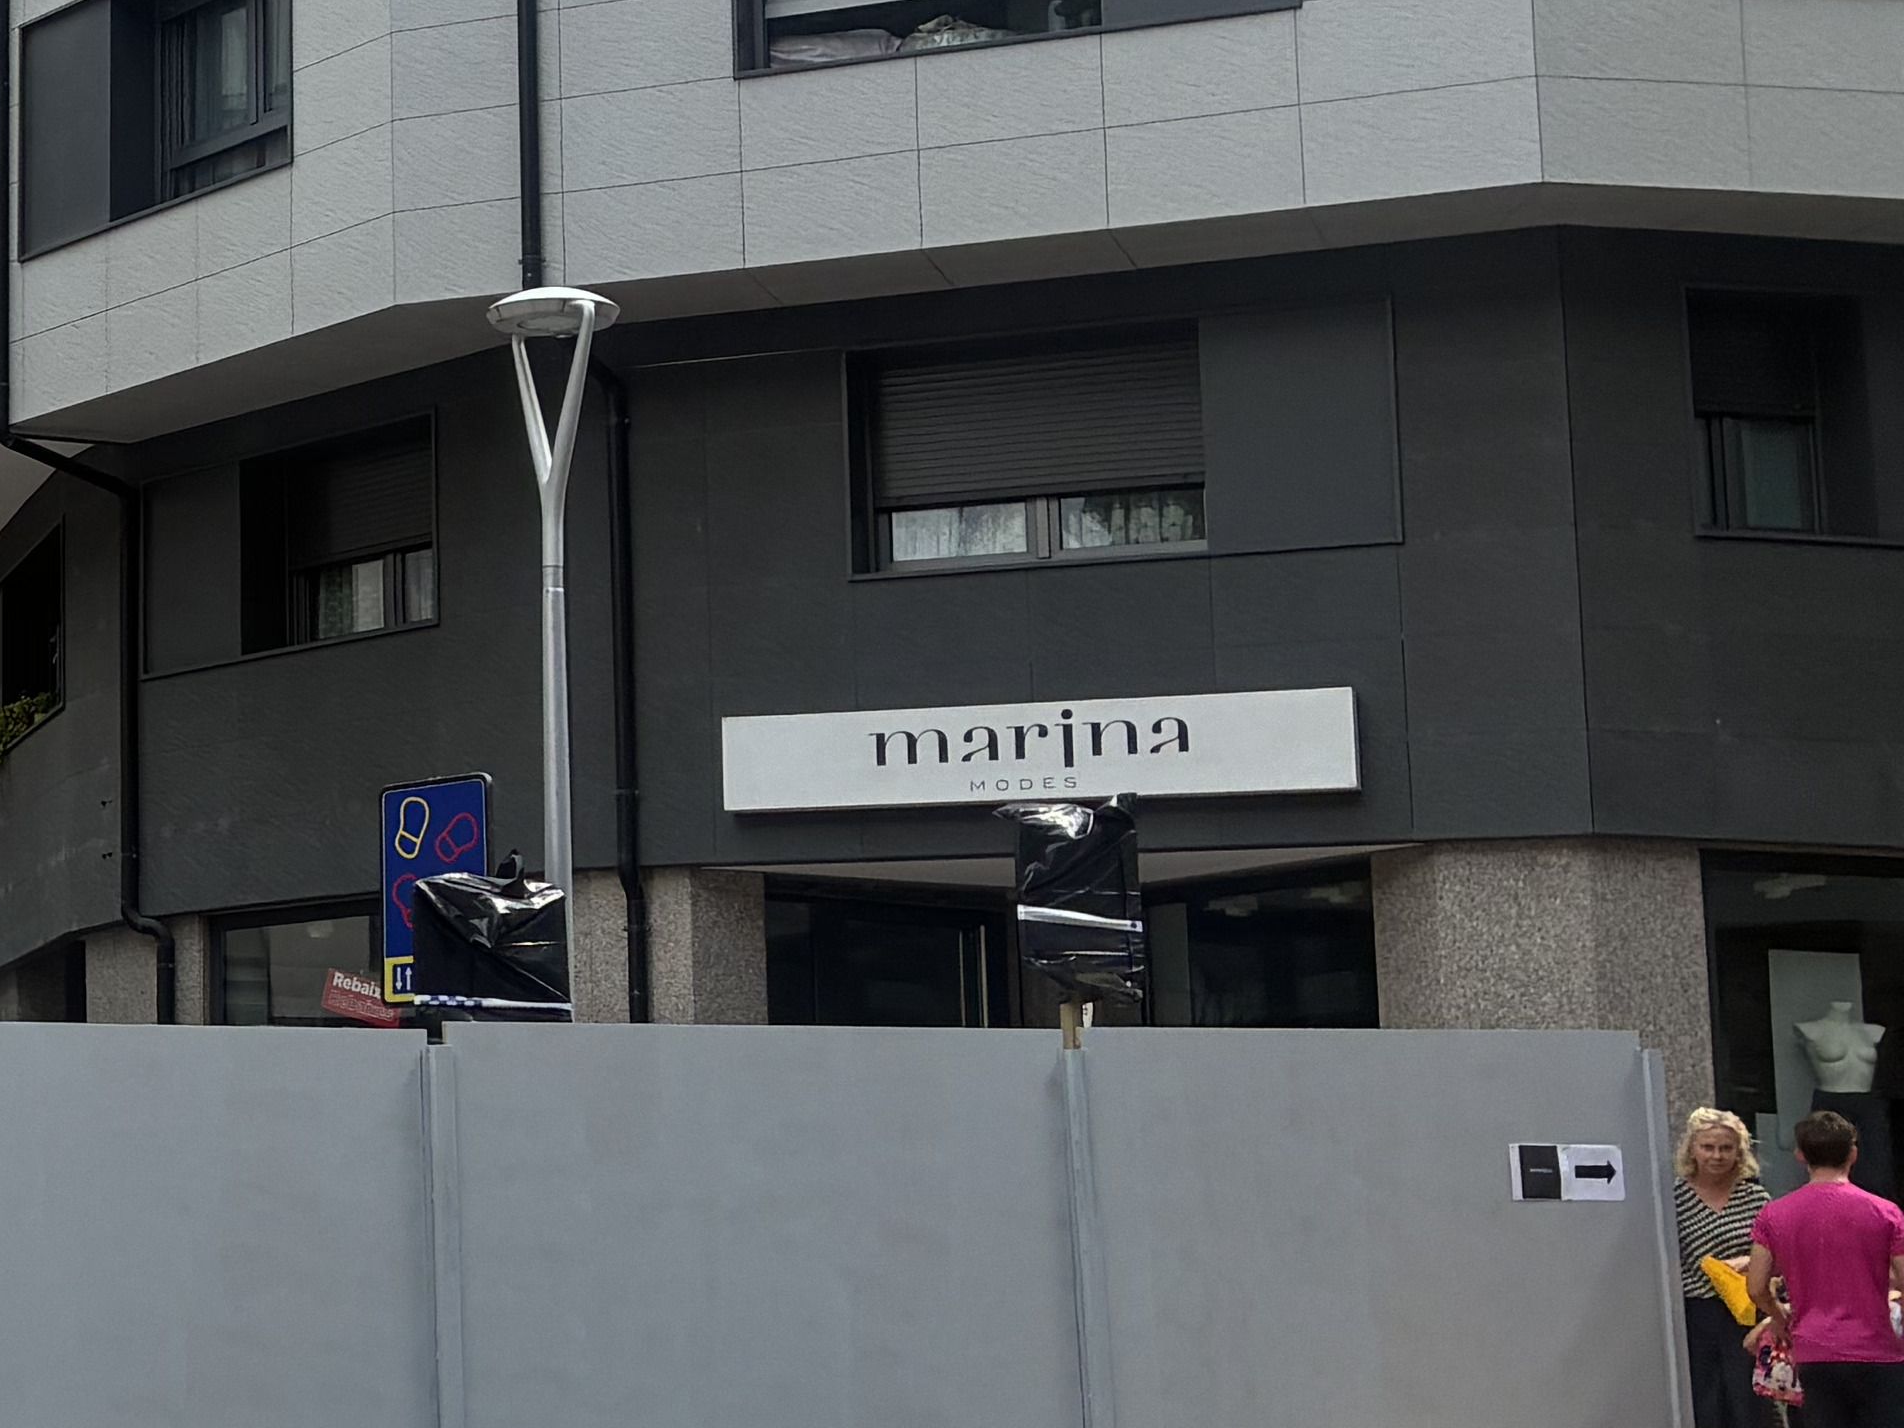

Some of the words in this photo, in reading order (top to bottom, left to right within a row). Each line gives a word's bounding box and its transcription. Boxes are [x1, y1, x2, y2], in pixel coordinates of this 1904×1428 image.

[869, 708, 1189, 768] marina
[971, 776, 1077, 791] MODES
[332, 971, 382, 1000] Rebaix
